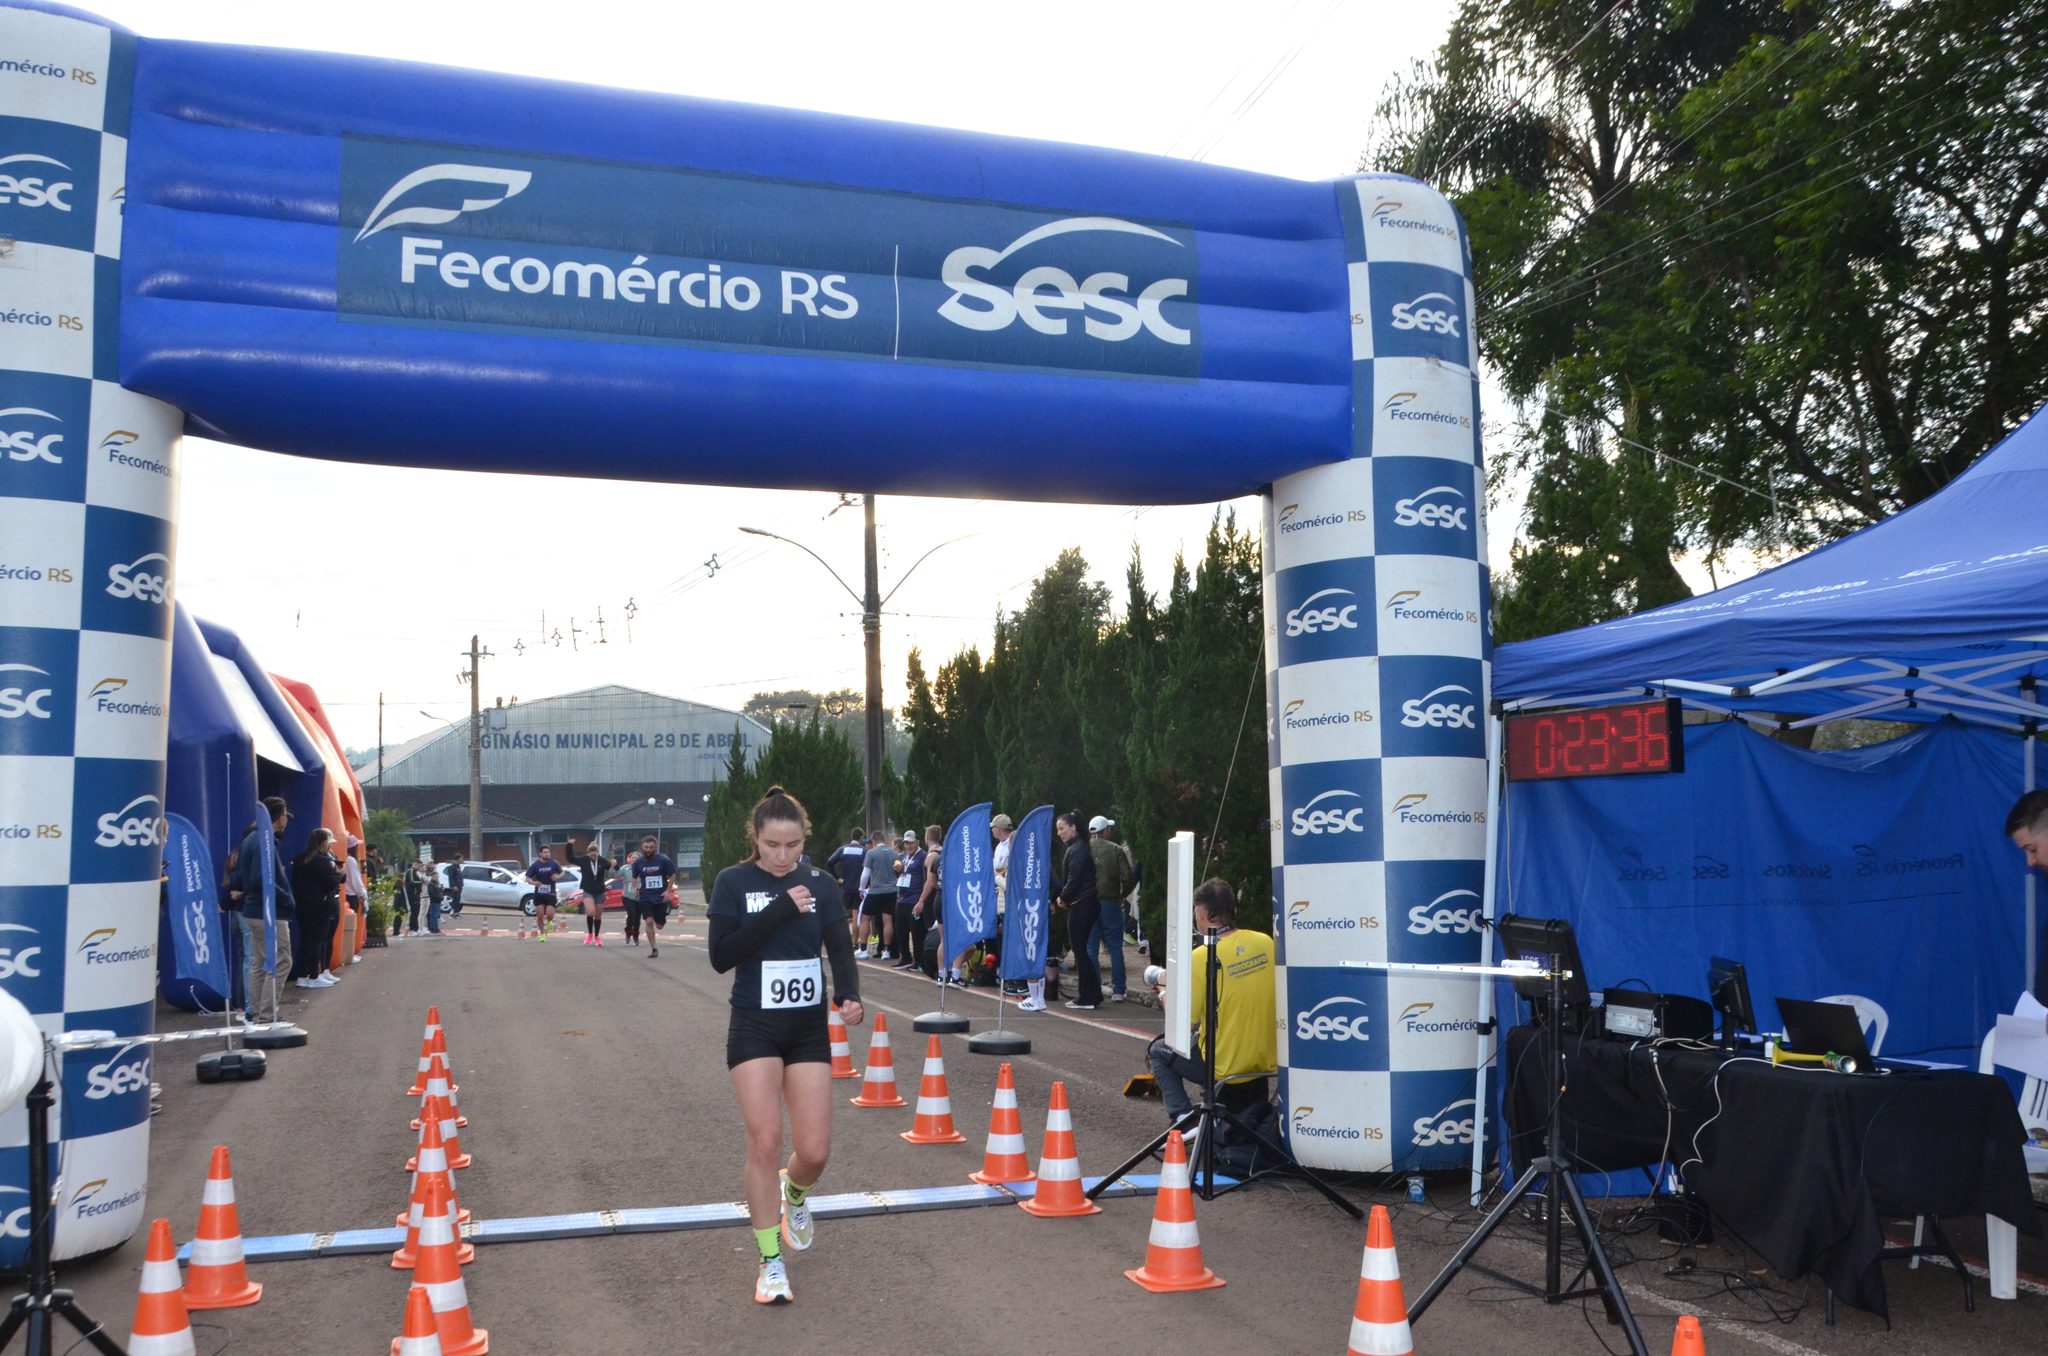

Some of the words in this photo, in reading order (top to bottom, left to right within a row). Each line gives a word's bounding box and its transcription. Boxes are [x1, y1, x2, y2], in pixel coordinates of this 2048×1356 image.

[72, 68, 97, 86] RS
[1380, 217, 1444, 235] Fecomércio
[400, 236, 761, 312] Fecomércio
[781, 271, 859, 319] RS
[937, 246, 1191, 345] Sesc
[59, 315, 84, 331] RS
[1391, 302, 1460, 338] Sesc
[1391, 409, 1457, 425] Fecomércio
[1459, 416, 1471, 429] RS
[1281, 514, 1343, 534] Fecomércio
[1347, 510, 1367, 523] RS
[1394, 499, 1467, 531] Sesc
[48, 568, 73, 583] RS
[1286, 605, 1358, 637] Sesc
[1394, 608, 1463, 621] Fecomércio
[1466, 611, 1478, 624] RS
[97, 699, 162, 716] Fecomércio
[1400, 699, 1476, 729] Sesc
[1287, 713, 1349, 729] Fecomércio
[1354, 711, 1373, 722] RS
[481, 731, 550, 749] GINÁSIO
[559, 733, 648, 749] MUNICIPAL
[654, 733, 676, 748] 29
[680, 733, 702, 748] DE
[1291, 808, 1363, 836] Sesc
[1401, 811, 1471, 823] Fecomércio
[1474, 811, 1486, 823] RS
[36, 825, 62, 839] RS
[962, 825, 971, 874] Fecomércio
[966, 880, 984, 934] Sesc
[1292, 917, 1355, 930] Fecomércio
[1360, 917, 1379, 929] RS
[87, 946, 151, 965] Fecomércio
[770, 977, 815, 1004] 969
[1296, 1011, 1369, 1041] Sesc
[1407, 1019, 1478, 1033] Fecomércio
[1296, 1123, 1359, 1139] Fecomércio
[1364, 1128, 1383, 1140] RS
[78, 1187, 140, 1219] Fecomércio
